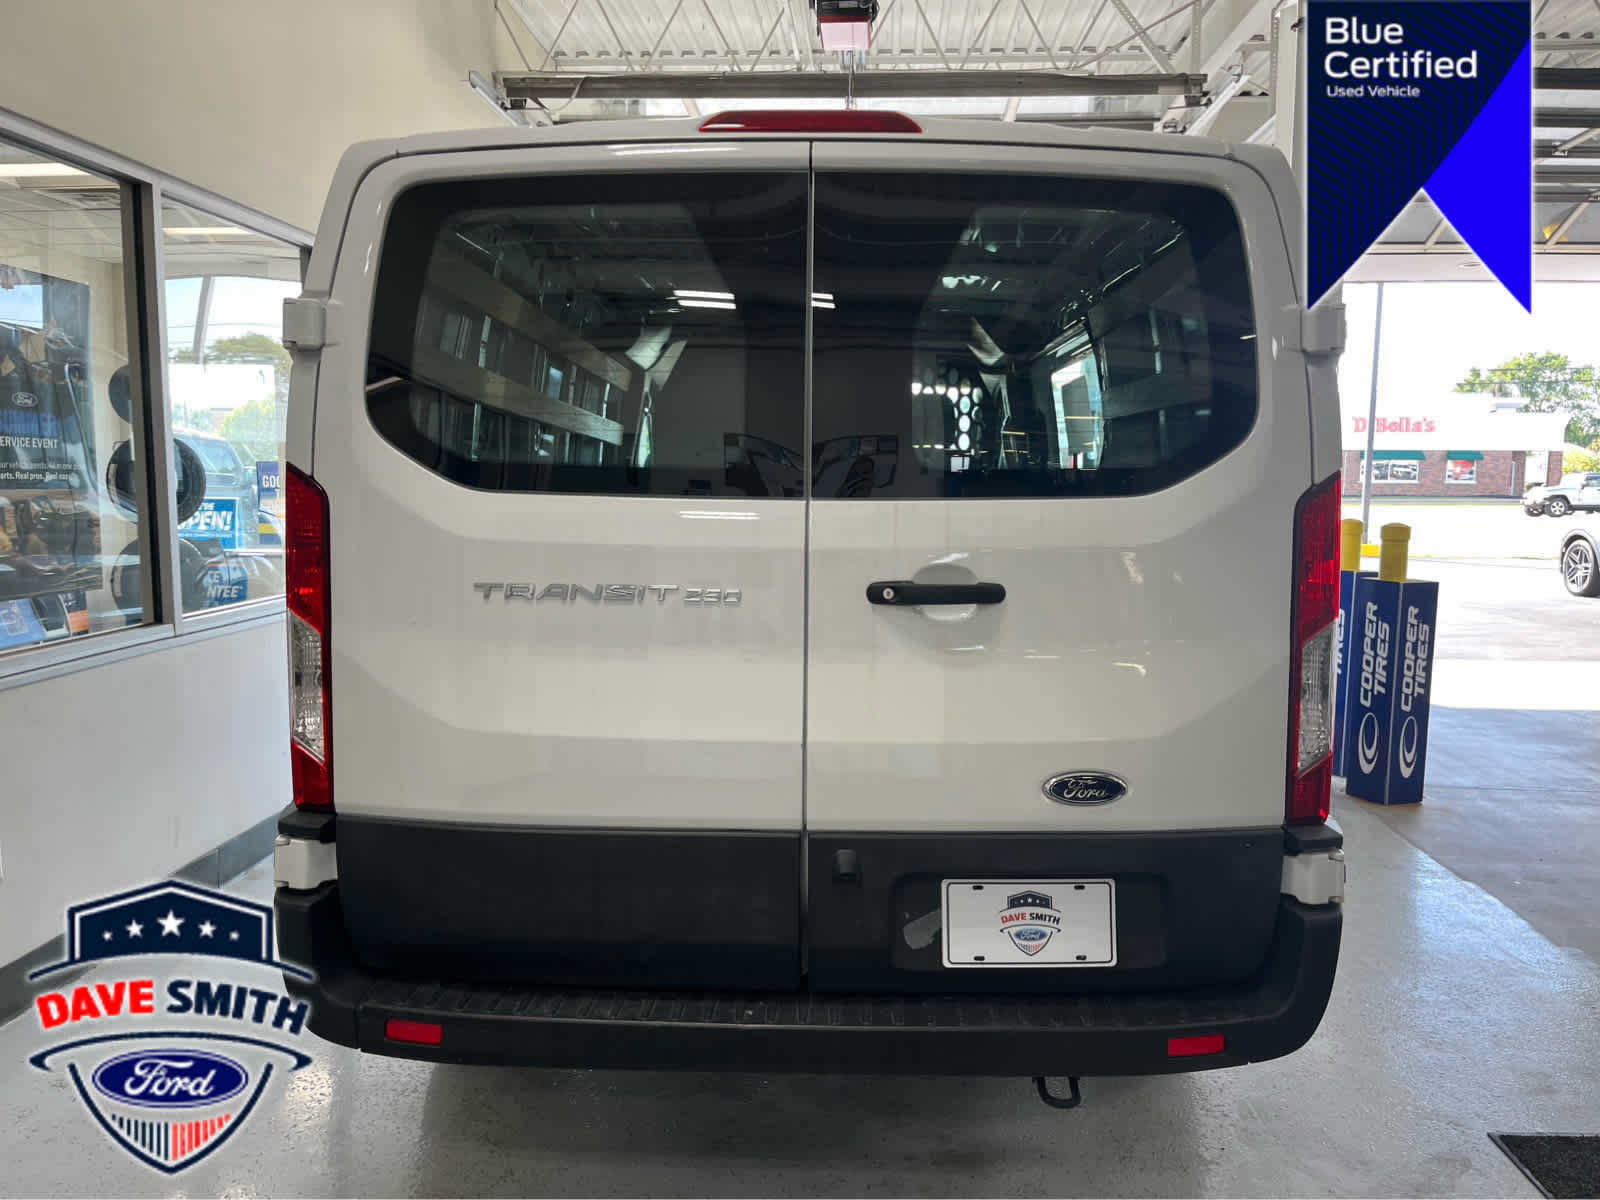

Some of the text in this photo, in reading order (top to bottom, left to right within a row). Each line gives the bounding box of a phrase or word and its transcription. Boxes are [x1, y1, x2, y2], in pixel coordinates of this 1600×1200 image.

[32, 438, 58, 449] EVENT
[473, 582, 680, 603] TRANSIT
[1360, 601, 1378, 708] COOPER
[1374, 620, 1390, 695] TIRES
[1401, 605, 1420, 713] COOPER
[1414, 623, 1430, 698] TIRES
[1062, 777, 1108, 798] Ford
[1001, 912, 1061, 925] DAVE SMITH
